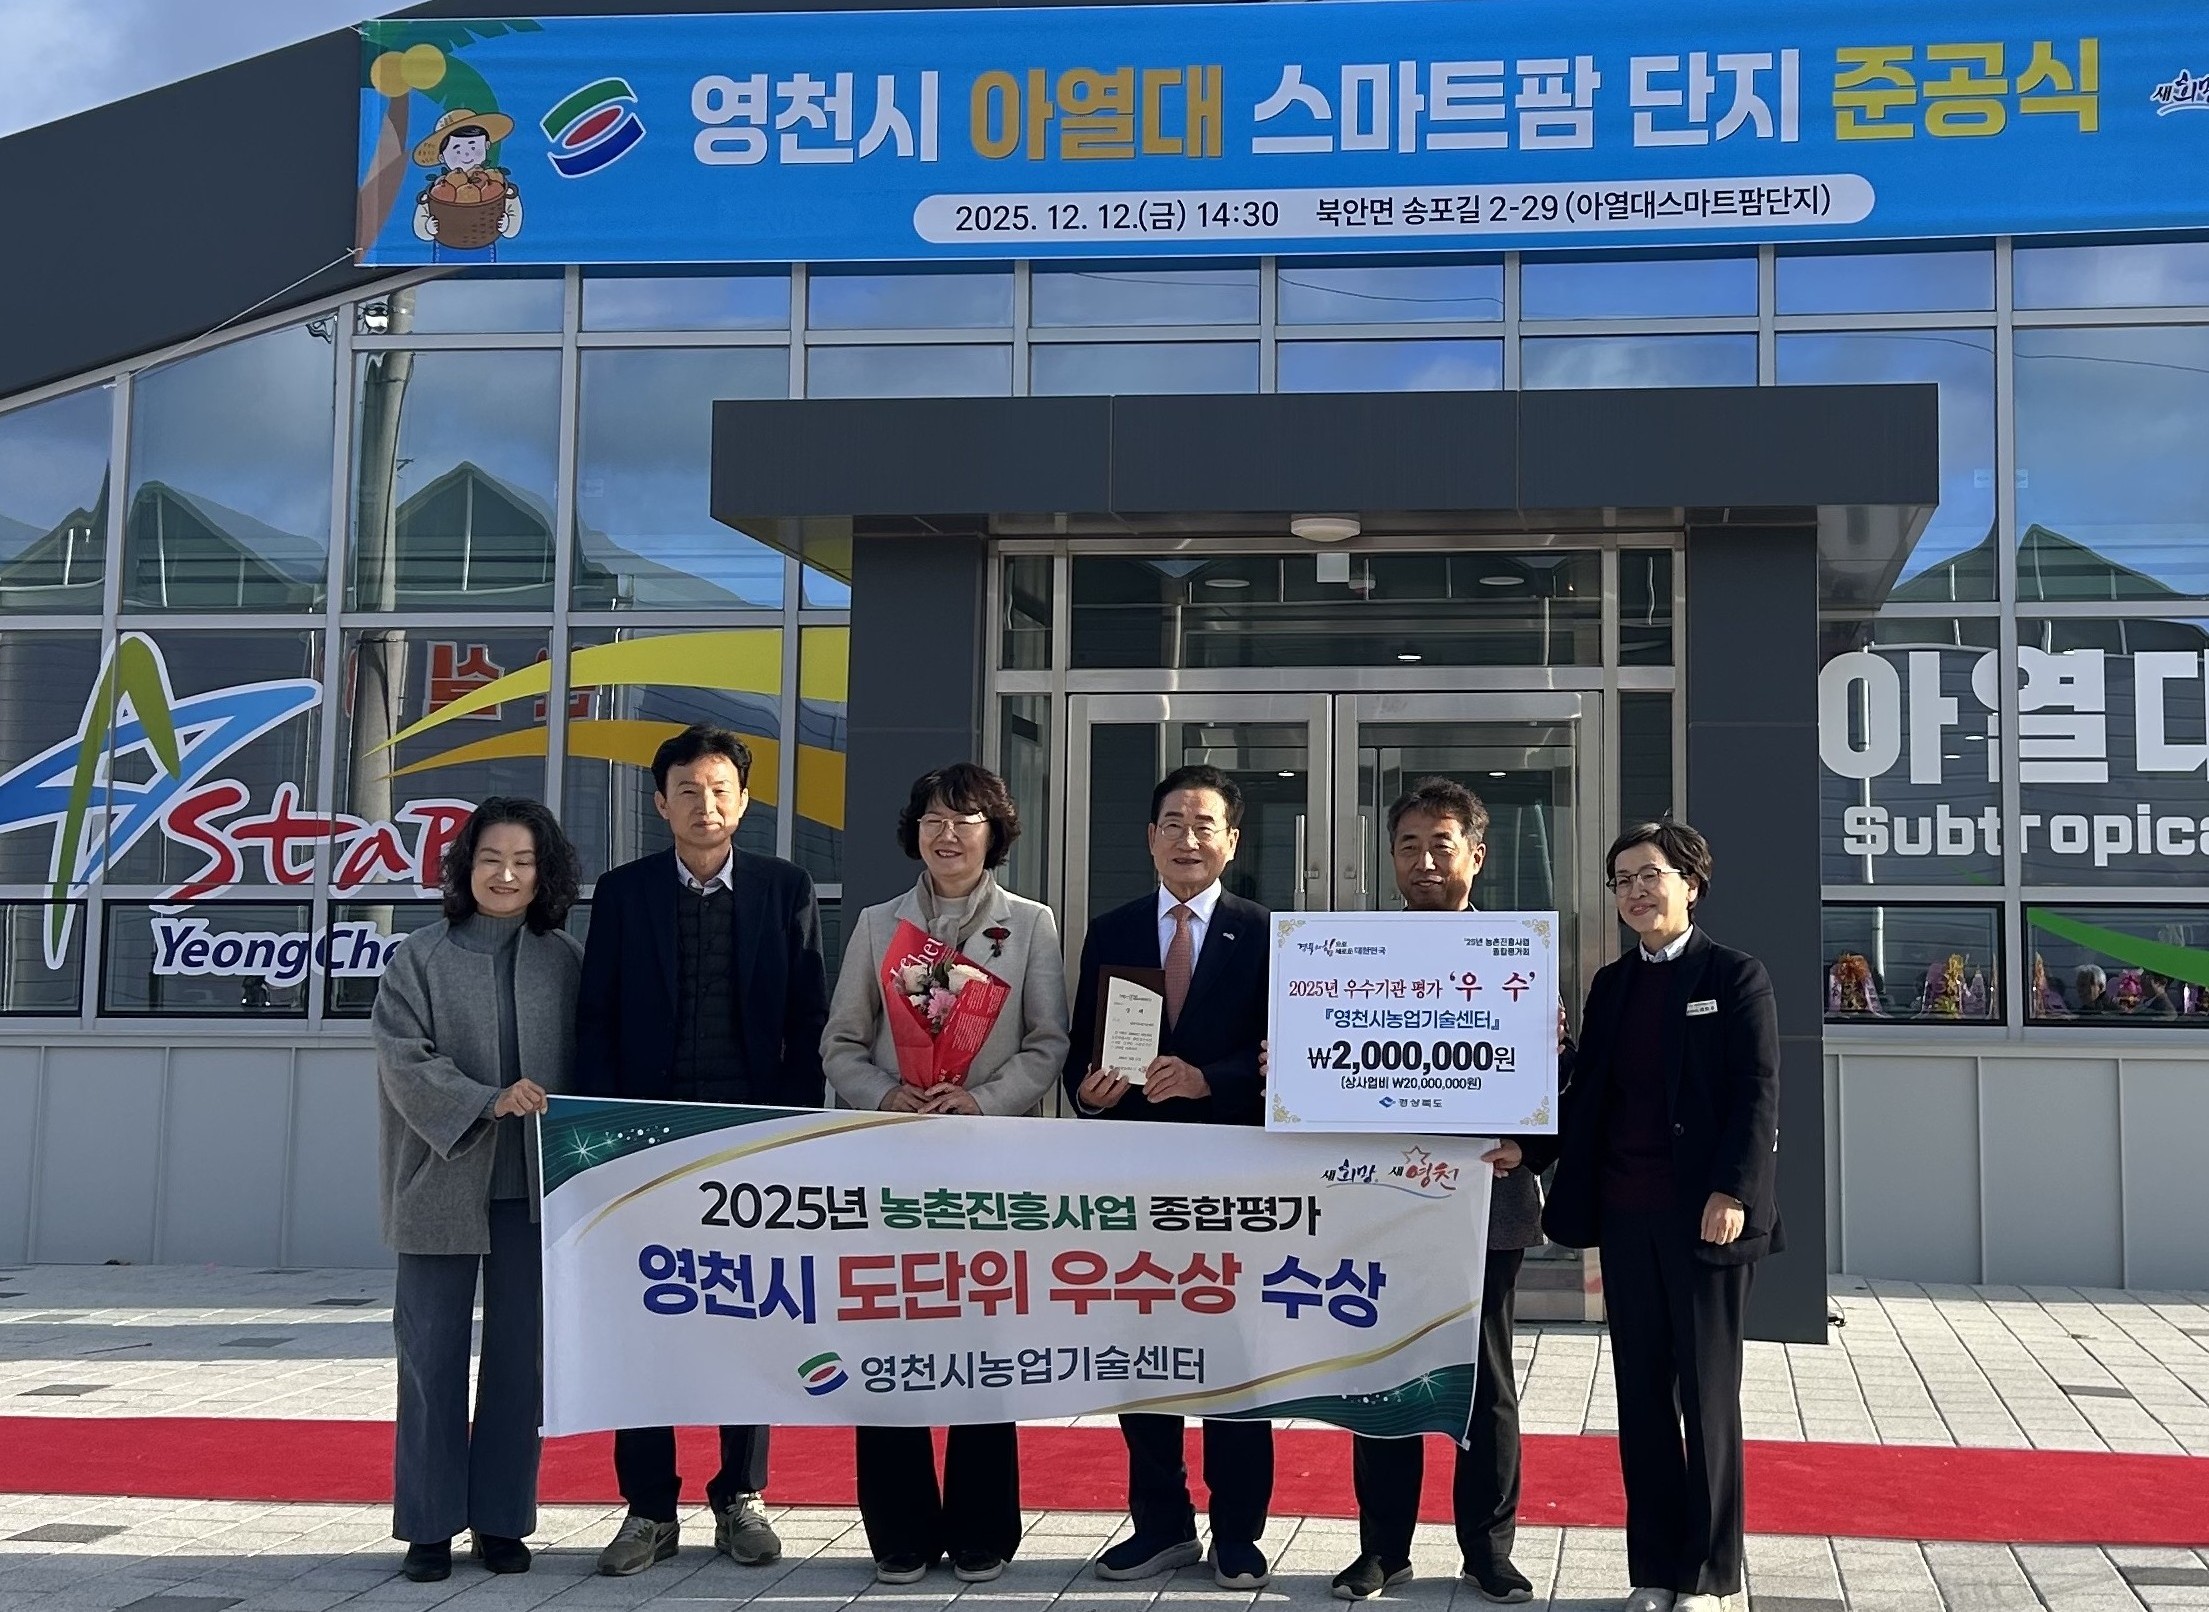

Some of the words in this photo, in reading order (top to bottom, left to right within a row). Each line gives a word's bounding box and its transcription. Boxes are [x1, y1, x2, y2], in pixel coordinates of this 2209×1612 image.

[691, 71, 940, 167] 영천시
[969, 64, 1224, 162] 아열대
[1251, 56, 1603, 155] 스마트팜
[1629, 48, 1801, 148] 단지
[1831, 37, 2100, 142] 준공식
[955, 205, 1037, 231] 2025.
[1047, 204, 1088, 230] 12.
[1197, 200, 1279, 228] 14:30
[1316, 196, 1394, 227] 북안면
[1401, 195, 1480, 226] 송포길
[1489, 194, 1559, 223] 2-29
[1565, 184, 1831, 225] (아열대스마트팜단지)
[1843, 804, 2209, 867] Subtropic
[1289, 978, 1339, 999] 2025년
[1343, 979, 1408, 1000] 우수기관
[1410, 979, 1443, 1000] 평가
[1341, 1076, 1389, 1090] (상사업비
[1399, 1098, 1443, 1108] 경상북도
[698, 1180, 869, 1231] 2025년
[879, 1186, 1138, 1231] 농촌진흥사업
[1149, 1195, 1322, 1237] 종합평가
[638, 1244, 817, 1325] 영천시
[837, 1249, 1029, 1322] 도단위
[1049, 1250, 1243, 1316] 우수상
[1261, 1254, 1387, 1329] 수상
[861, 1344, 1206, 1395] 영천시농업기술센터
